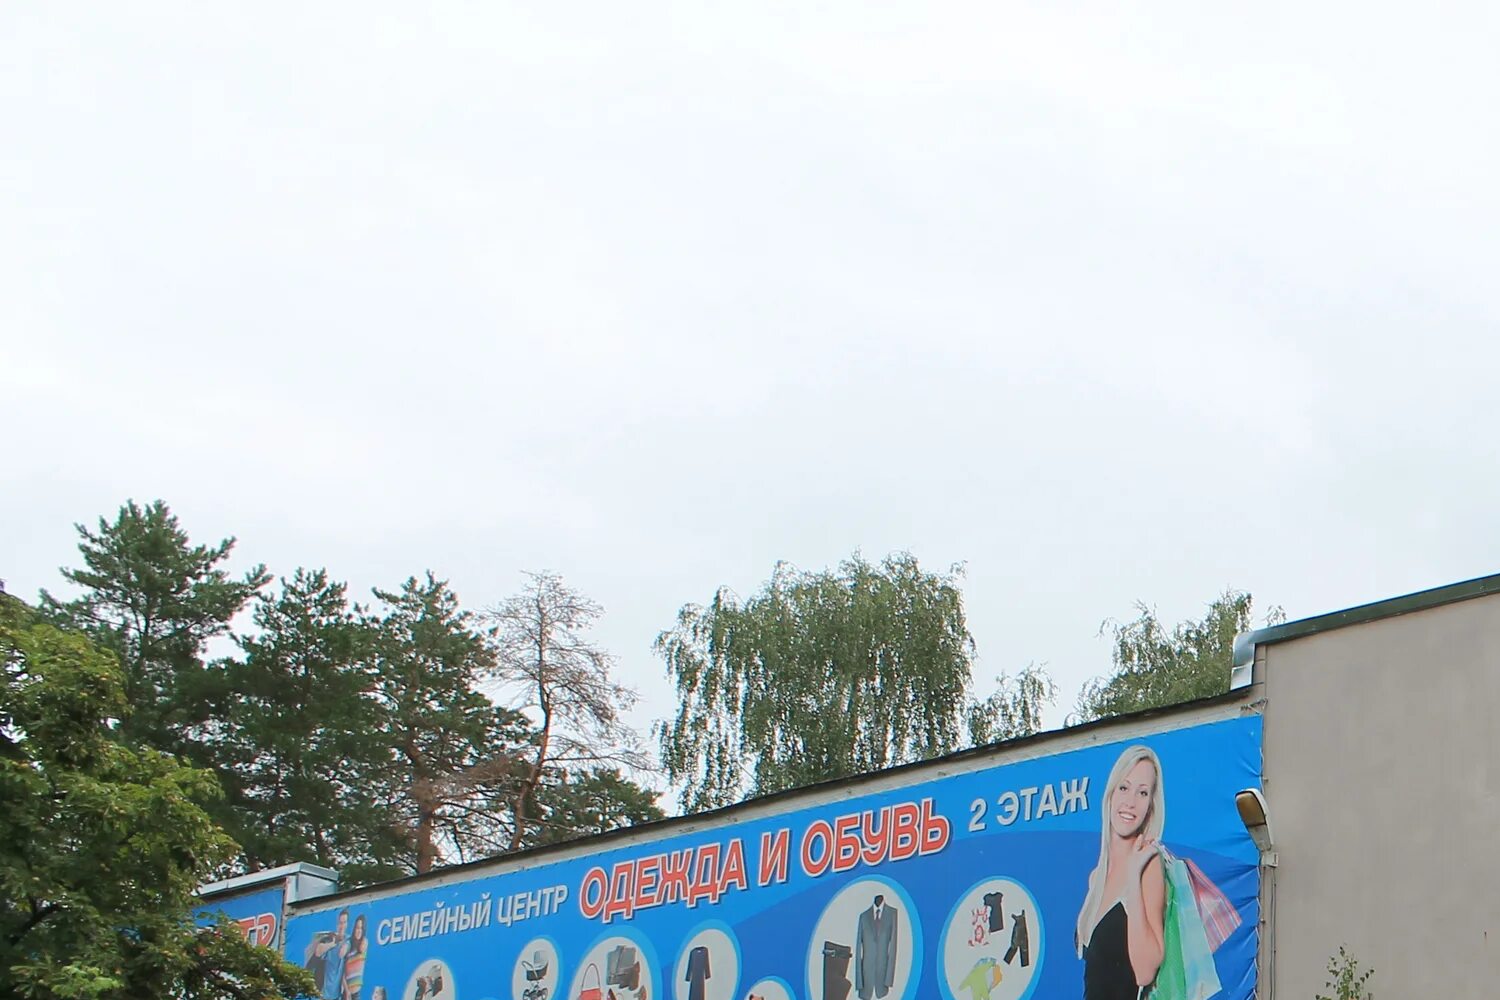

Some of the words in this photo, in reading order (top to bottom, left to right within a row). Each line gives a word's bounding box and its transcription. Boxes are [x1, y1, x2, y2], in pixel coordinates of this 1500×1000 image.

[377, 892, 491, 945] СЕМЕЙНЫЙ
[497, 885, 568, 927] ЦЕНТР
[580, 839, 747, 923] ОДЕЖДА
[757, 828, 789, 886] И
[800, 798, 952, 877] ОБУВЬ
[968, 798, 988, 832] 2
[996, 776, 1089, 826] ЭТАЖ
